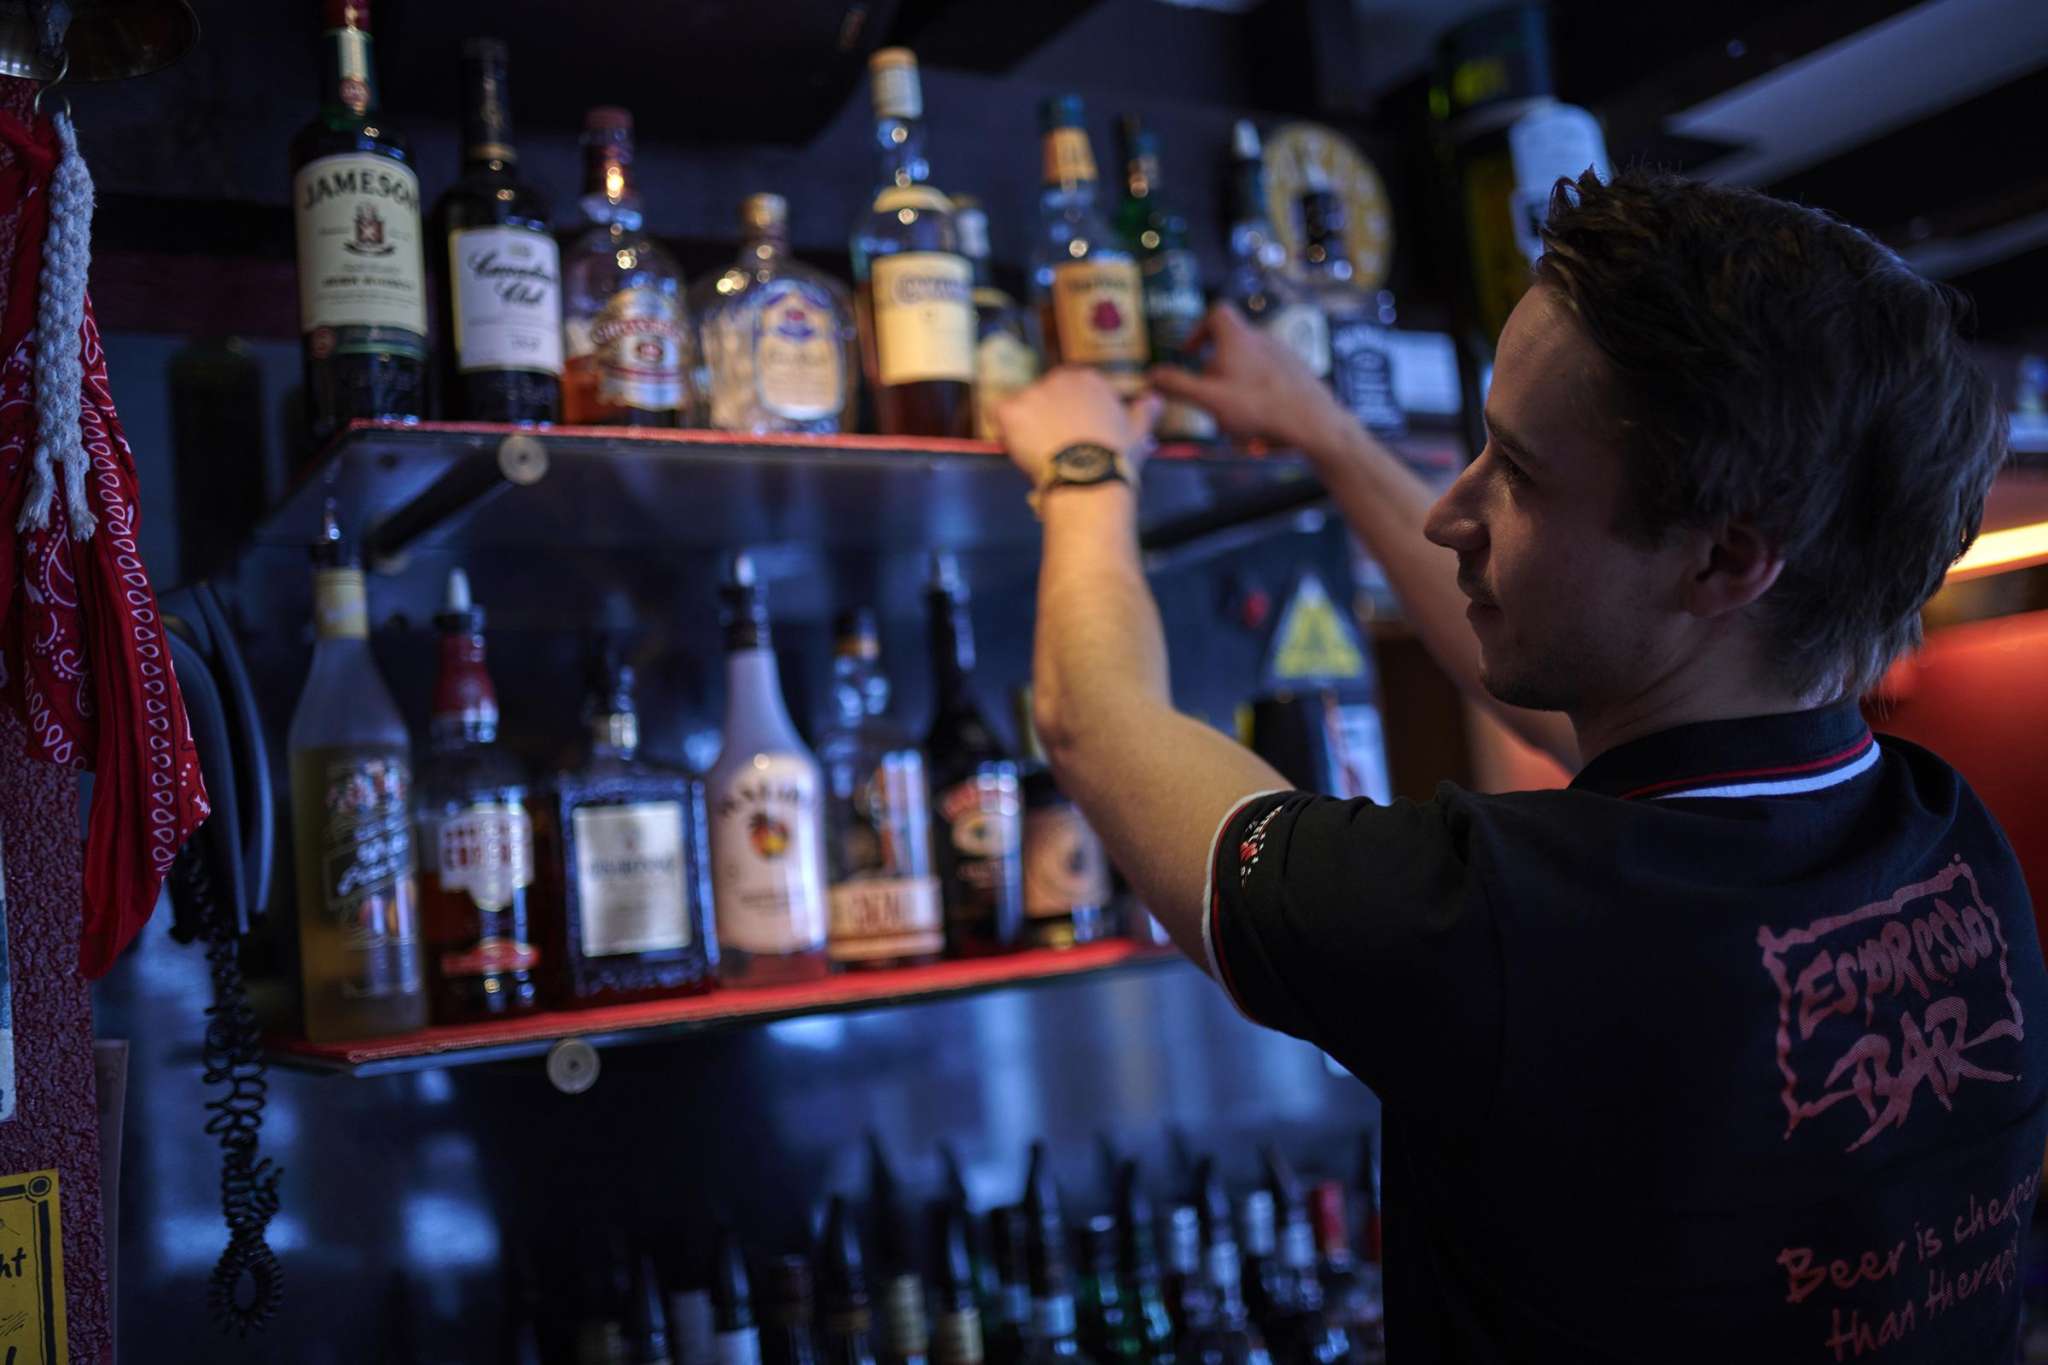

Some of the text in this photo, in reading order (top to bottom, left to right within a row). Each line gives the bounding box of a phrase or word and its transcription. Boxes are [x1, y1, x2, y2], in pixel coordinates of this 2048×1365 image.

[1822, 996, 2022, 1153] BAR
[1776, 1238, 1906, 1304] Beer
[1913, 1220, 1943, 1264] is
[1824, 1297, 1915, 1362] than
